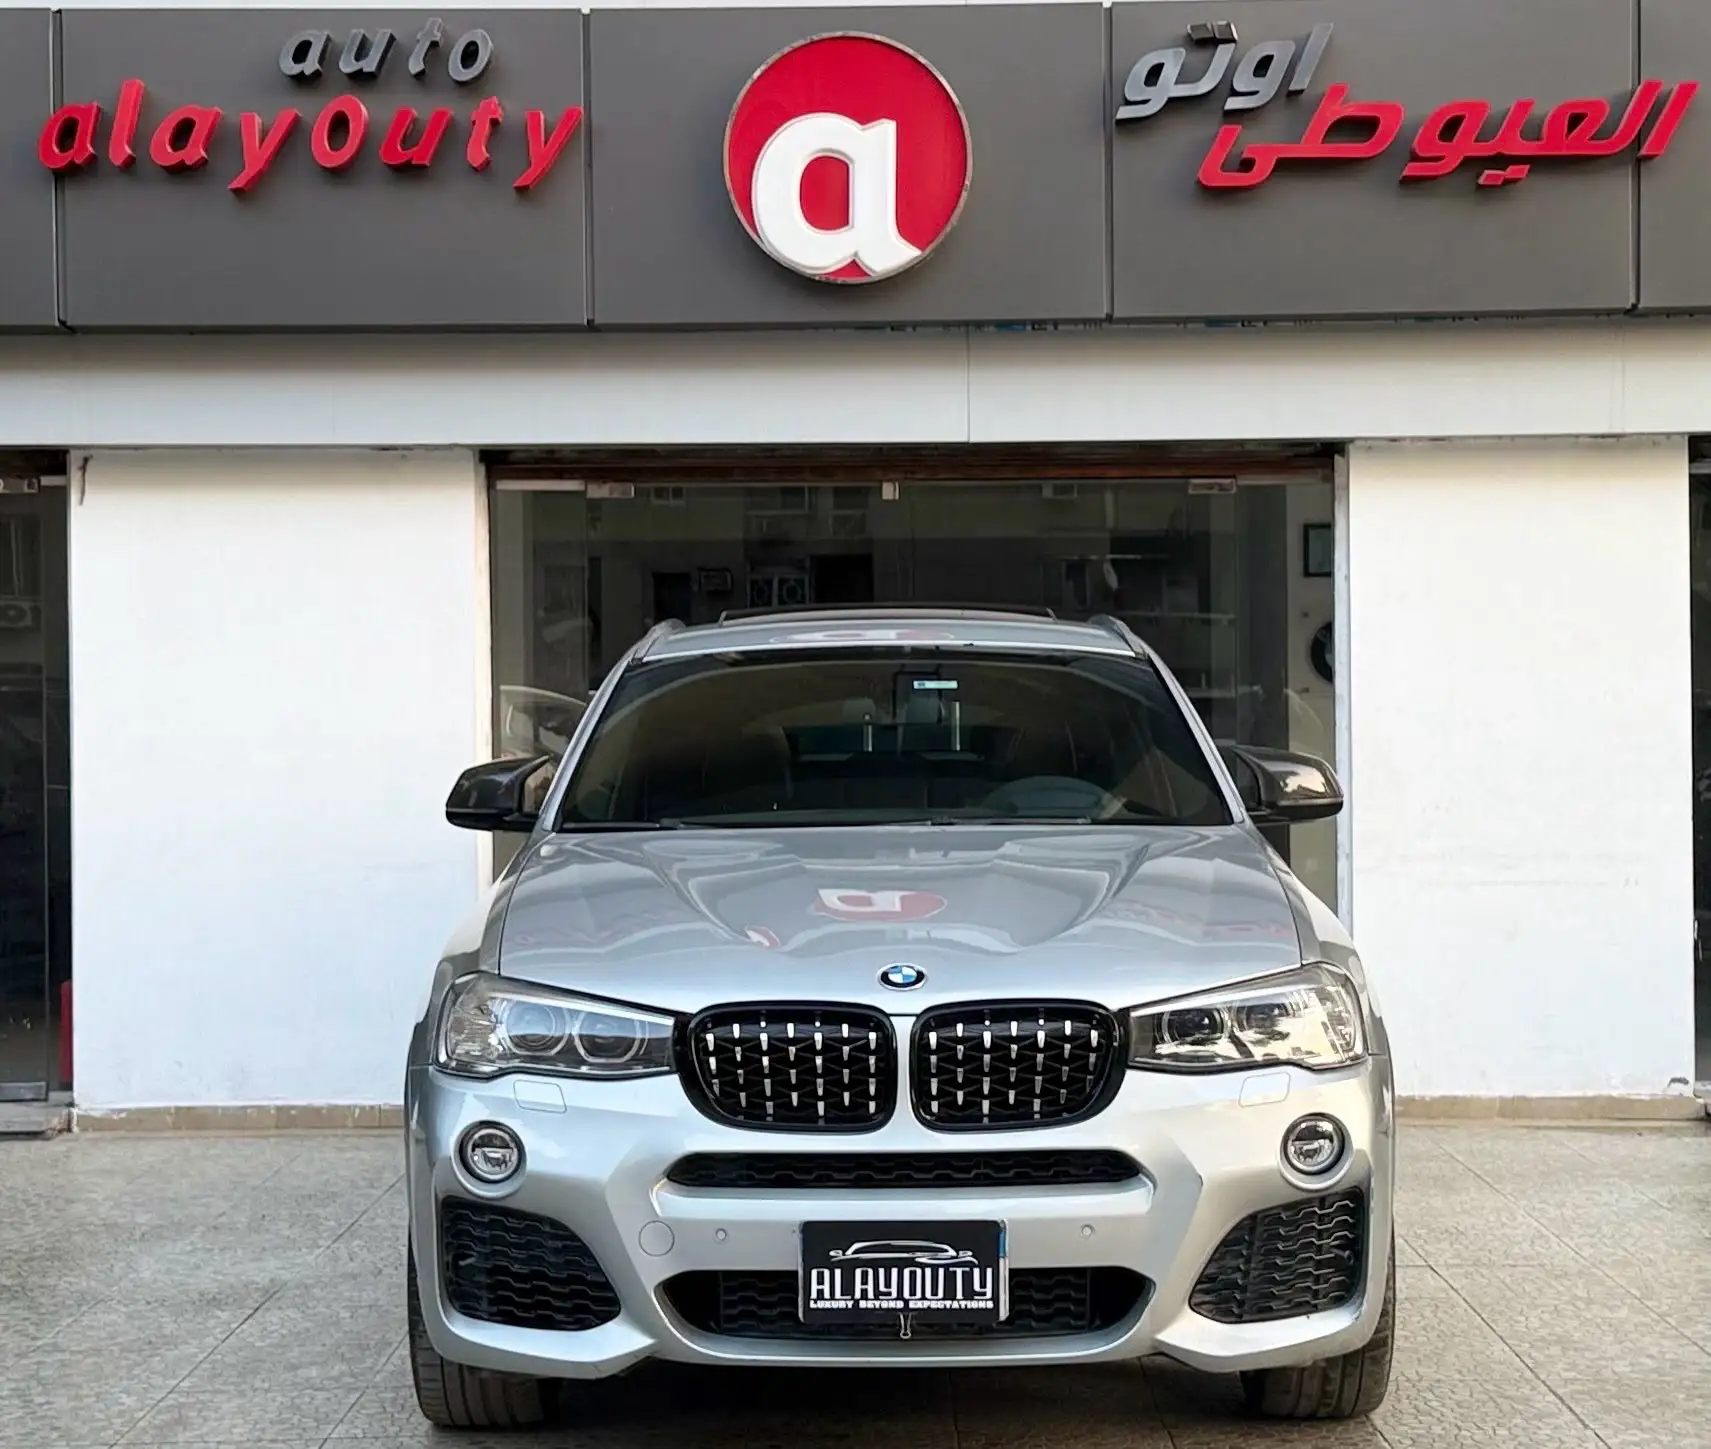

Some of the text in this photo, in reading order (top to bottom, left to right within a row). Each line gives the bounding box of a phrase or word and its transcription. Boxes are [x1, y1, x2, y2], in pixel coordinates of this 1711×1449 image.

[279, 17, 495, 82] auto
[1115, 21, 1334, 120] اوتو
[752, 112, 923, 276] a
[809, 1267, 993, 1300] ALAYOUTY
